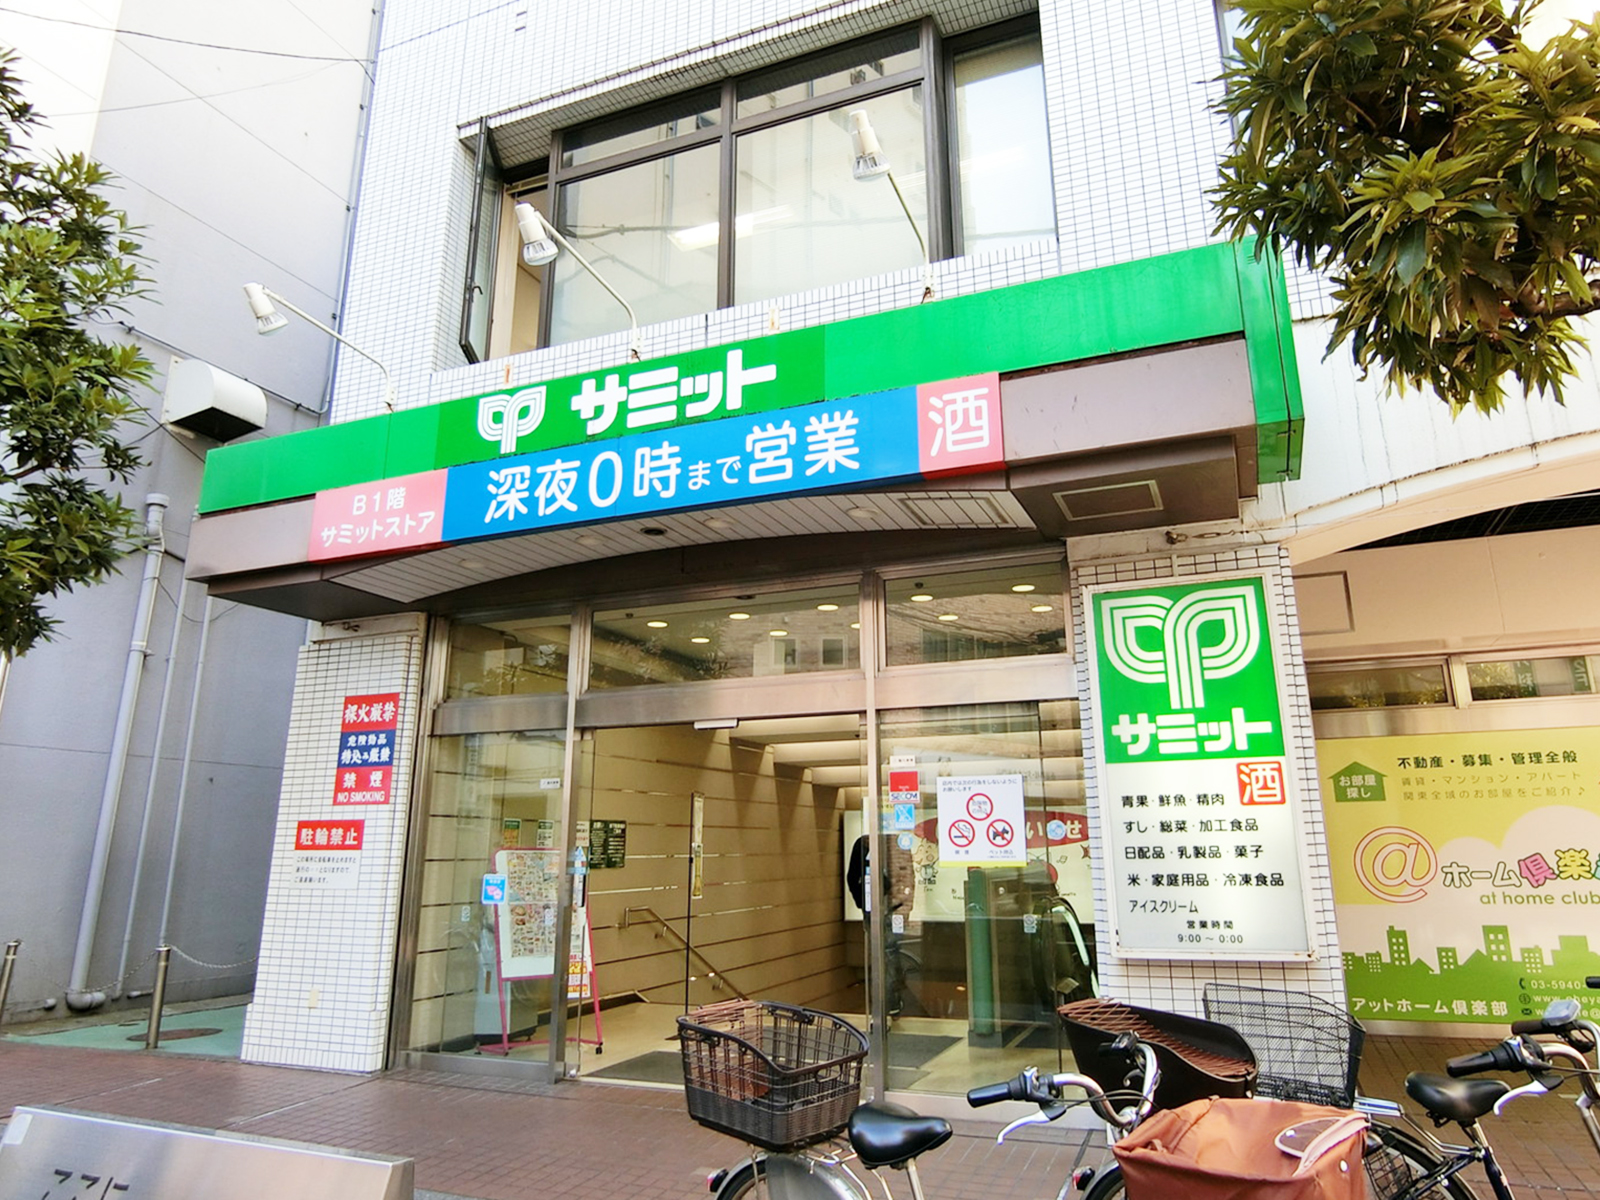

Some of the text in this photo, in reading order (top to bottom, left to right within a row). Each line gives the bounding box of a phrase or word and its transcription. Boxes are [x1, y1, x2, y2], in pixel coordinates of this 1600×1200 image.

[571, 349, 777, 438] サミット
[927, 386, 990, 458] 酒
[484, 409, 861, 524] 深夜0時まで営業
[352, 486, 407, 516] B1階
[320, 510, 436, 548] サミットストア
[343, 701, 397, 724] 裸火厳禁
[1111, 707, 1273, 756] サミット
[1397, 750, 1579, 770] 不動産・募集・管理全般
[1239, 762, 1285, 805] 酒
[1338, 775, 1377, 787] お部屋
[336, 790, 386, 803] NO SMOKING
[1346, 786, 1372, 799] 探し
[299, 827, 359, 845] 駐輪禁止
[1129, 899, 1199, 914] アイスクリーム
[1480, 890, 1600, 905] at home club
[1186, 919, 1234, 930] 営業時間
[1351, 997, 1510, 1017] アットホーム倶楽部
